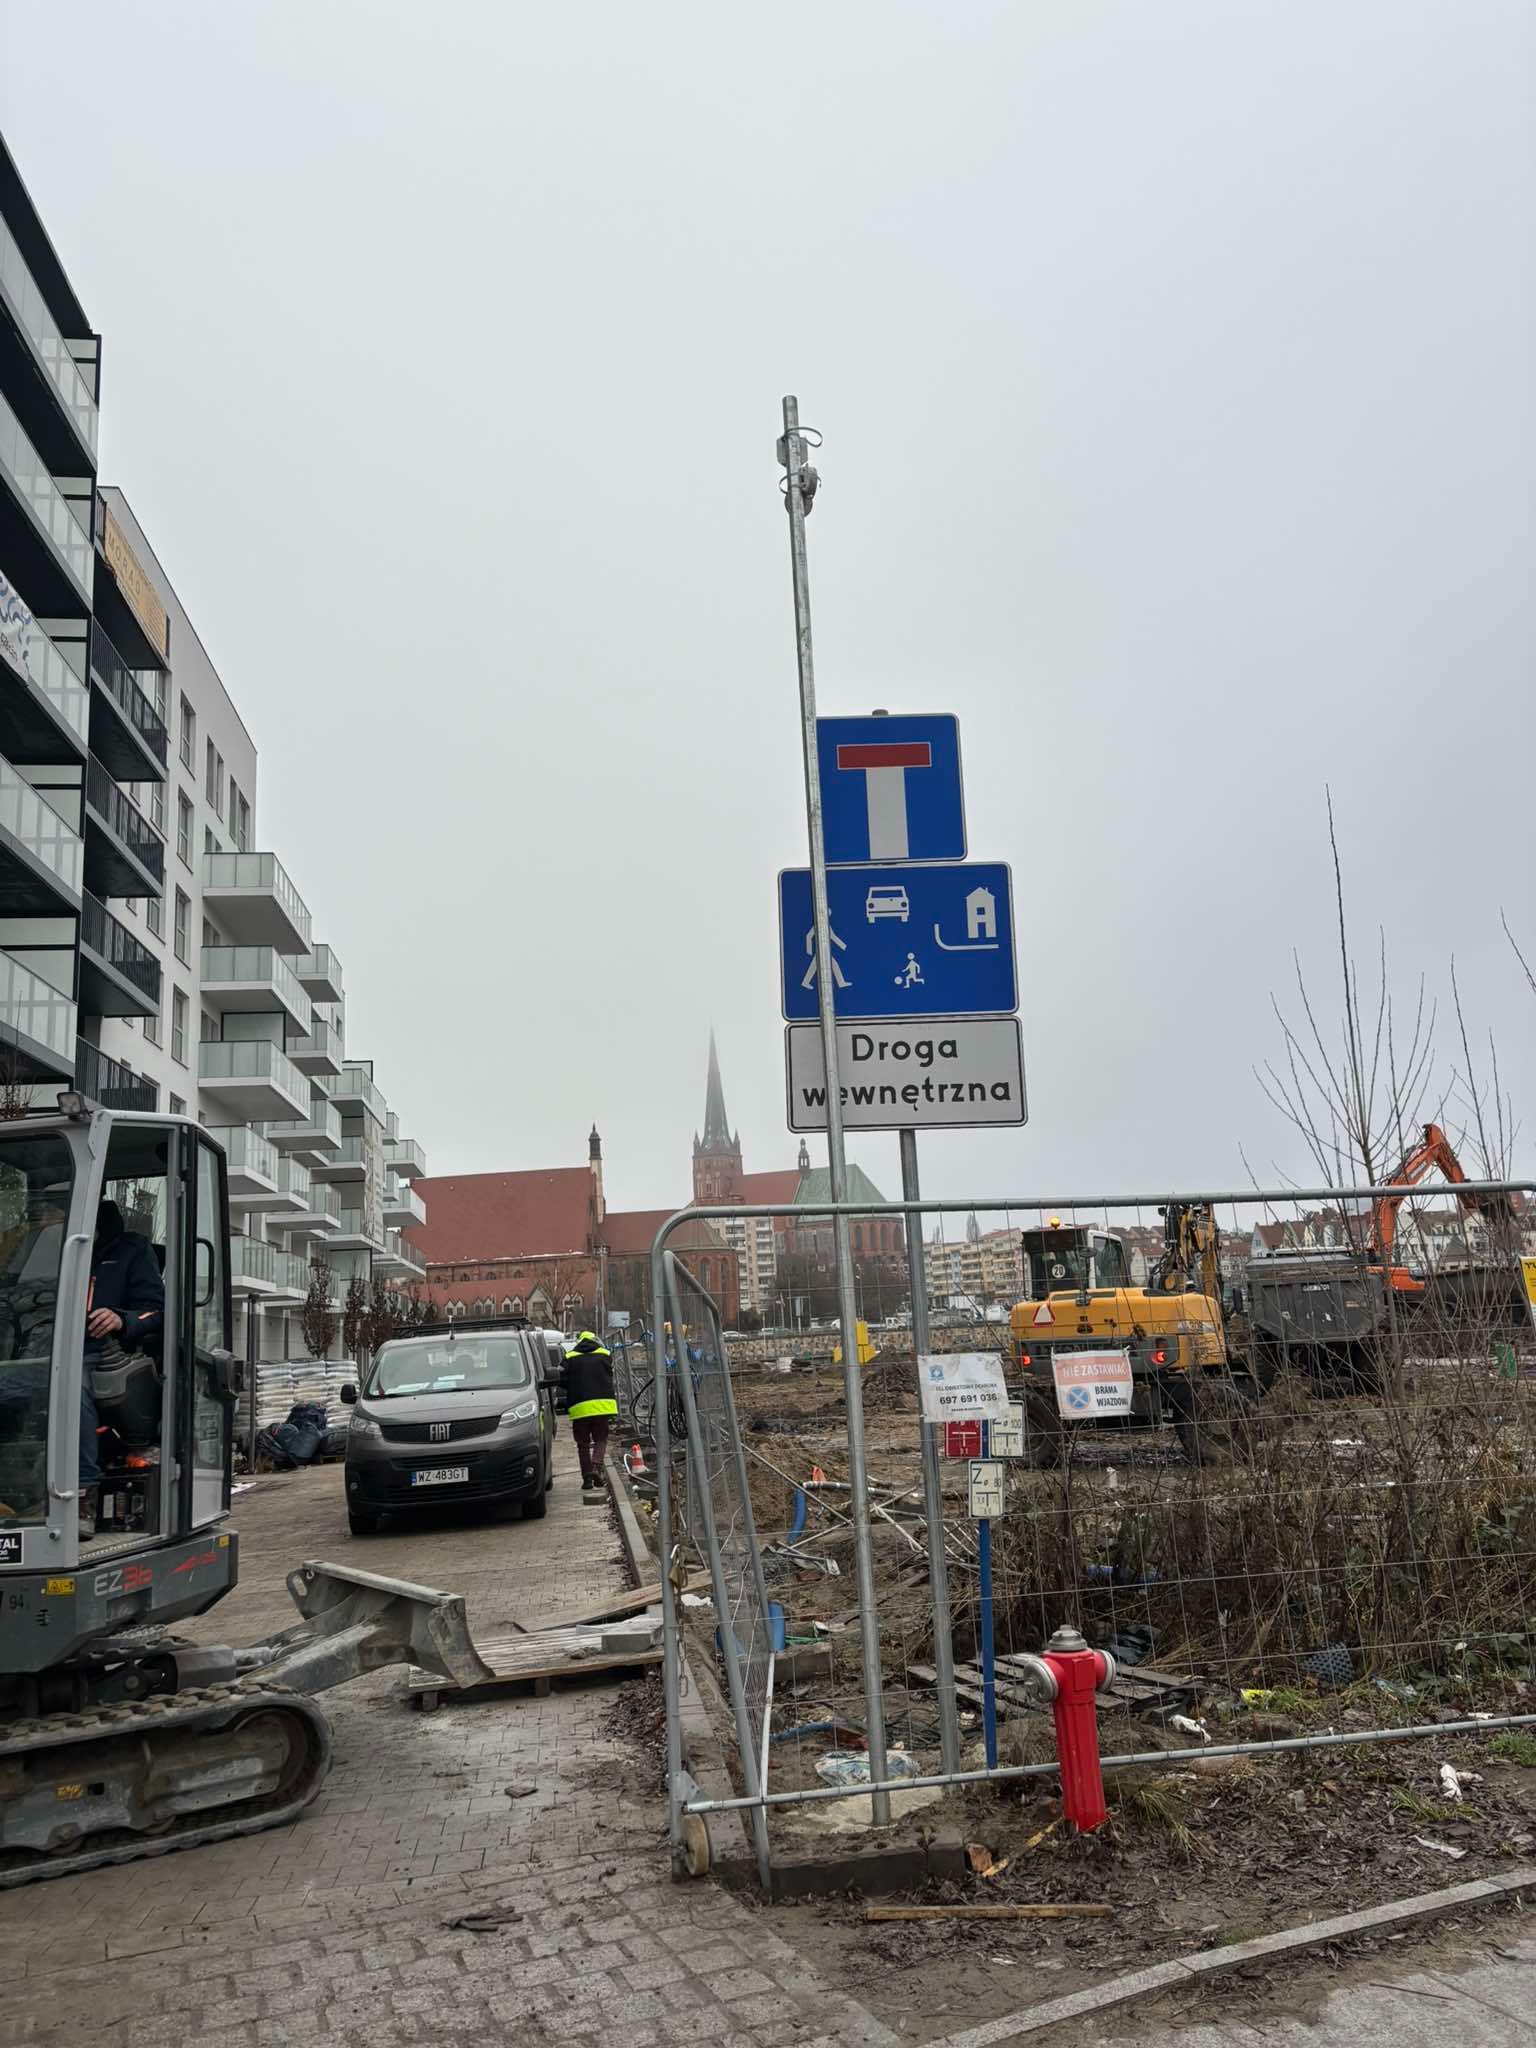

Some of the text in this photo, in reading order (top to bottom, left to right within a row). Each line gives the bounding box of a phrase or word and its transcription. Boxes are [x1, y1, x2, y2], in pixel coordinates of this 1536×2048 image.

[851, 1033, 959, 1068] Droga
[1054, 1266, 1064, 1276] 20
[1063, 1361, 1127, 1377] NIE ZASTAWIAĆ
[1095, 1385, 1119, 1395] BRAMA
[939, 1395, 957, 1405] 697
[960, 1394, 977, 1403] 691
[429, 1422, 452, 1441] FIAT
[418, 1468, 467, 1483] WZ 483GT
[972, 1467, 982, 1484] Z
